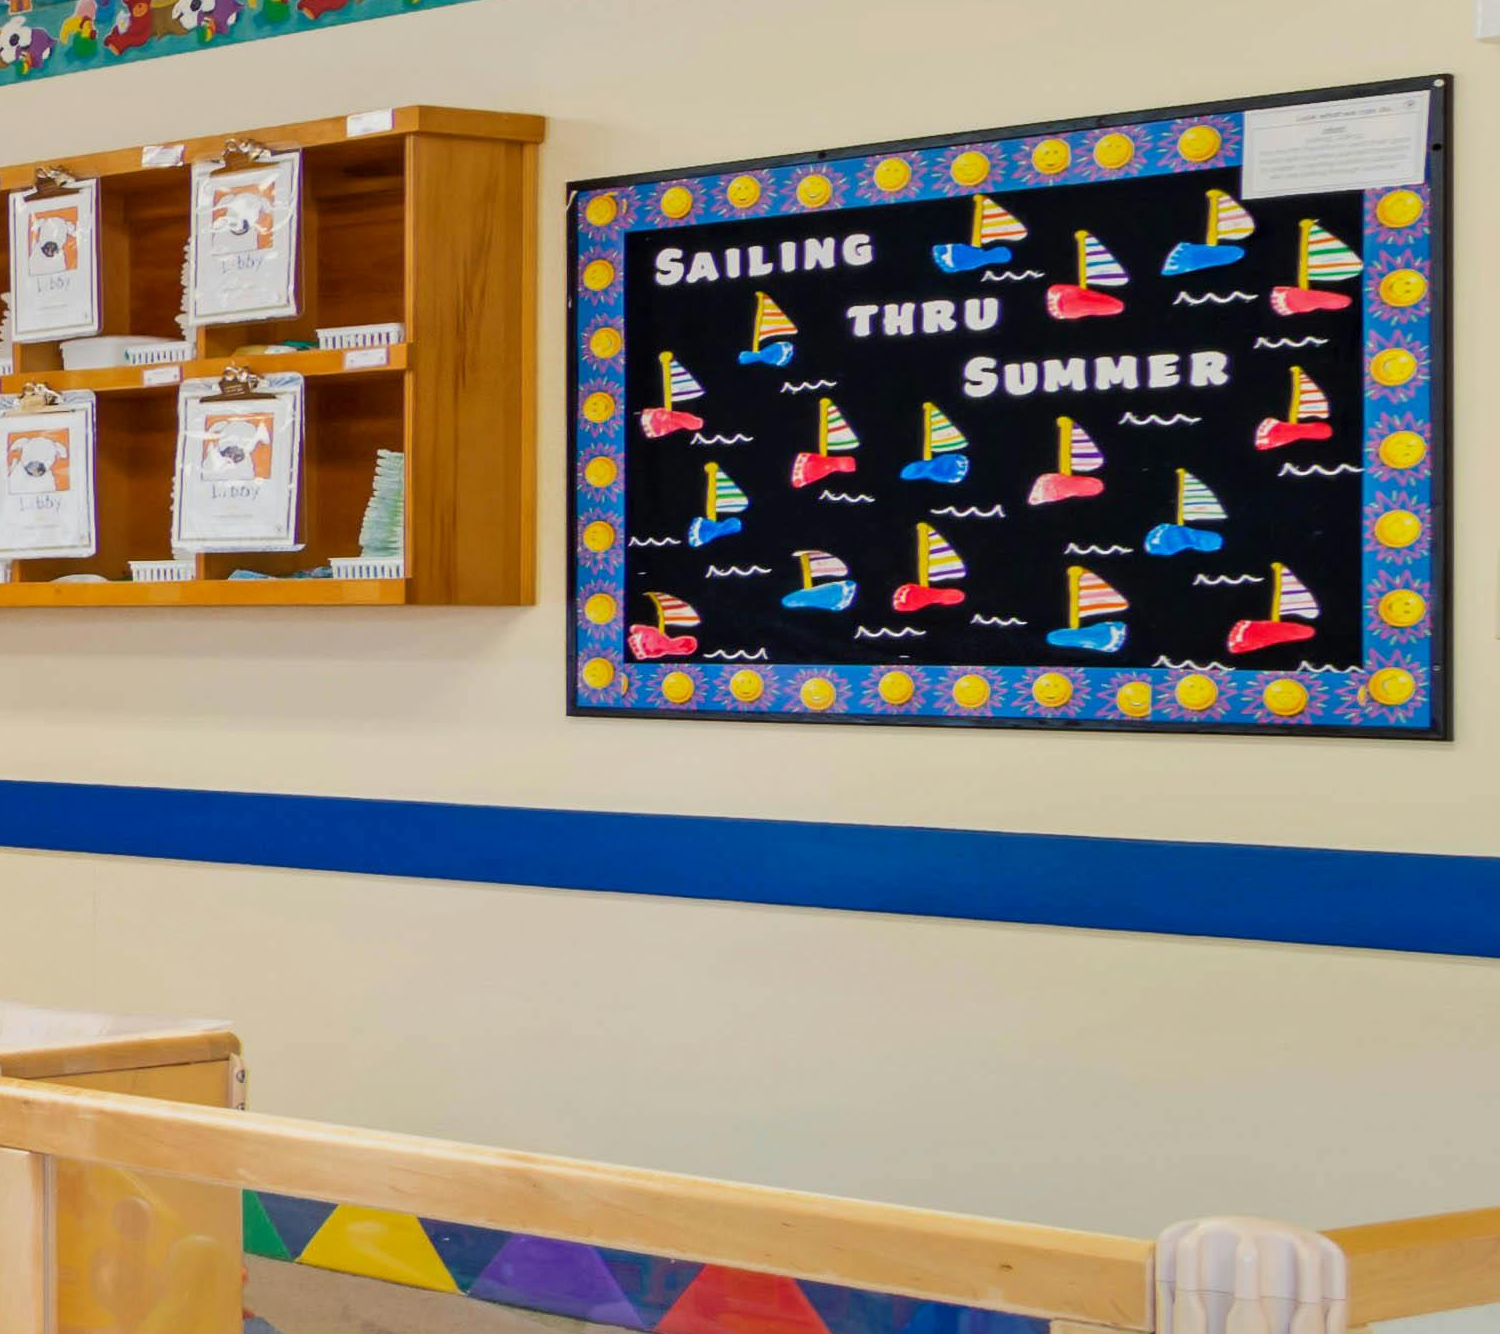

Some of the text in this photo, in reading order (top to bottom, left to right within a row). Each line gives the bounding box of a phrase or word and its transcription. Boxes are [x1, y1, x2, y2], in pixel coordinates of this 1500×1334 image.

[221, 254, 265, 275] Lbby
[654, 233, 874, 286] SAILING
[846, 297, 1000, 338] THRU
[963, 351, 1230, 398] SUMMER
